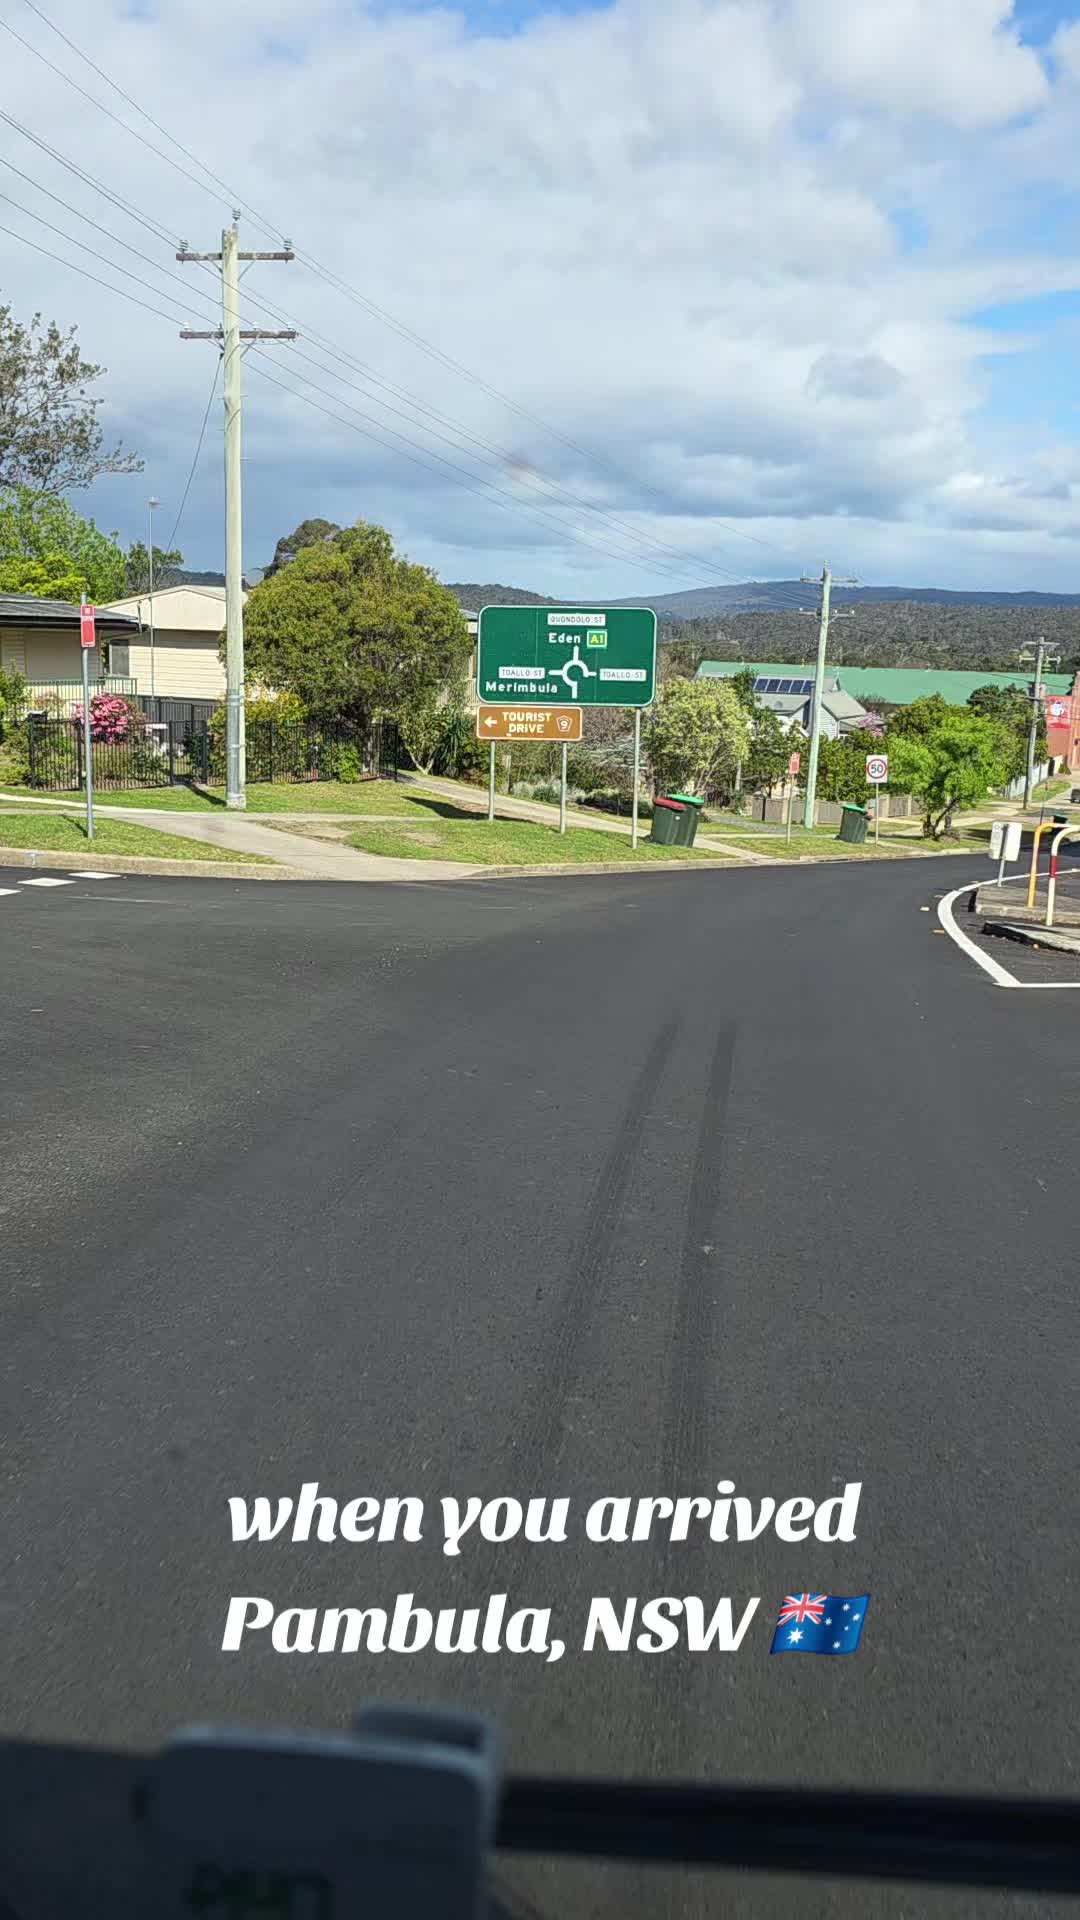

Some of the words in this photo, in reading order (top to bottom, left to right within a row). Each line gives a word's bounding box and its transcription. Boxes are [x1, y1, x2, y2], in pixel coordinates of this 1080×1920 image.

[593, 616, 603, 624] ST
[548, 632, 581, 644] Eden
[590, 634, 604, 644] A1
[501, 669, 531, 677] TOALLO
[533, 669, 543, 677] ST
[635, 671, 644, 679] ST
[485, 681, 558, 694] Merimbula
[502, 711, 552, 722] TOURIST
[508, 723, 545, 734] DRIVE
[560, 720, 568, 730] 9
[870, 764, 884, 774] 50
